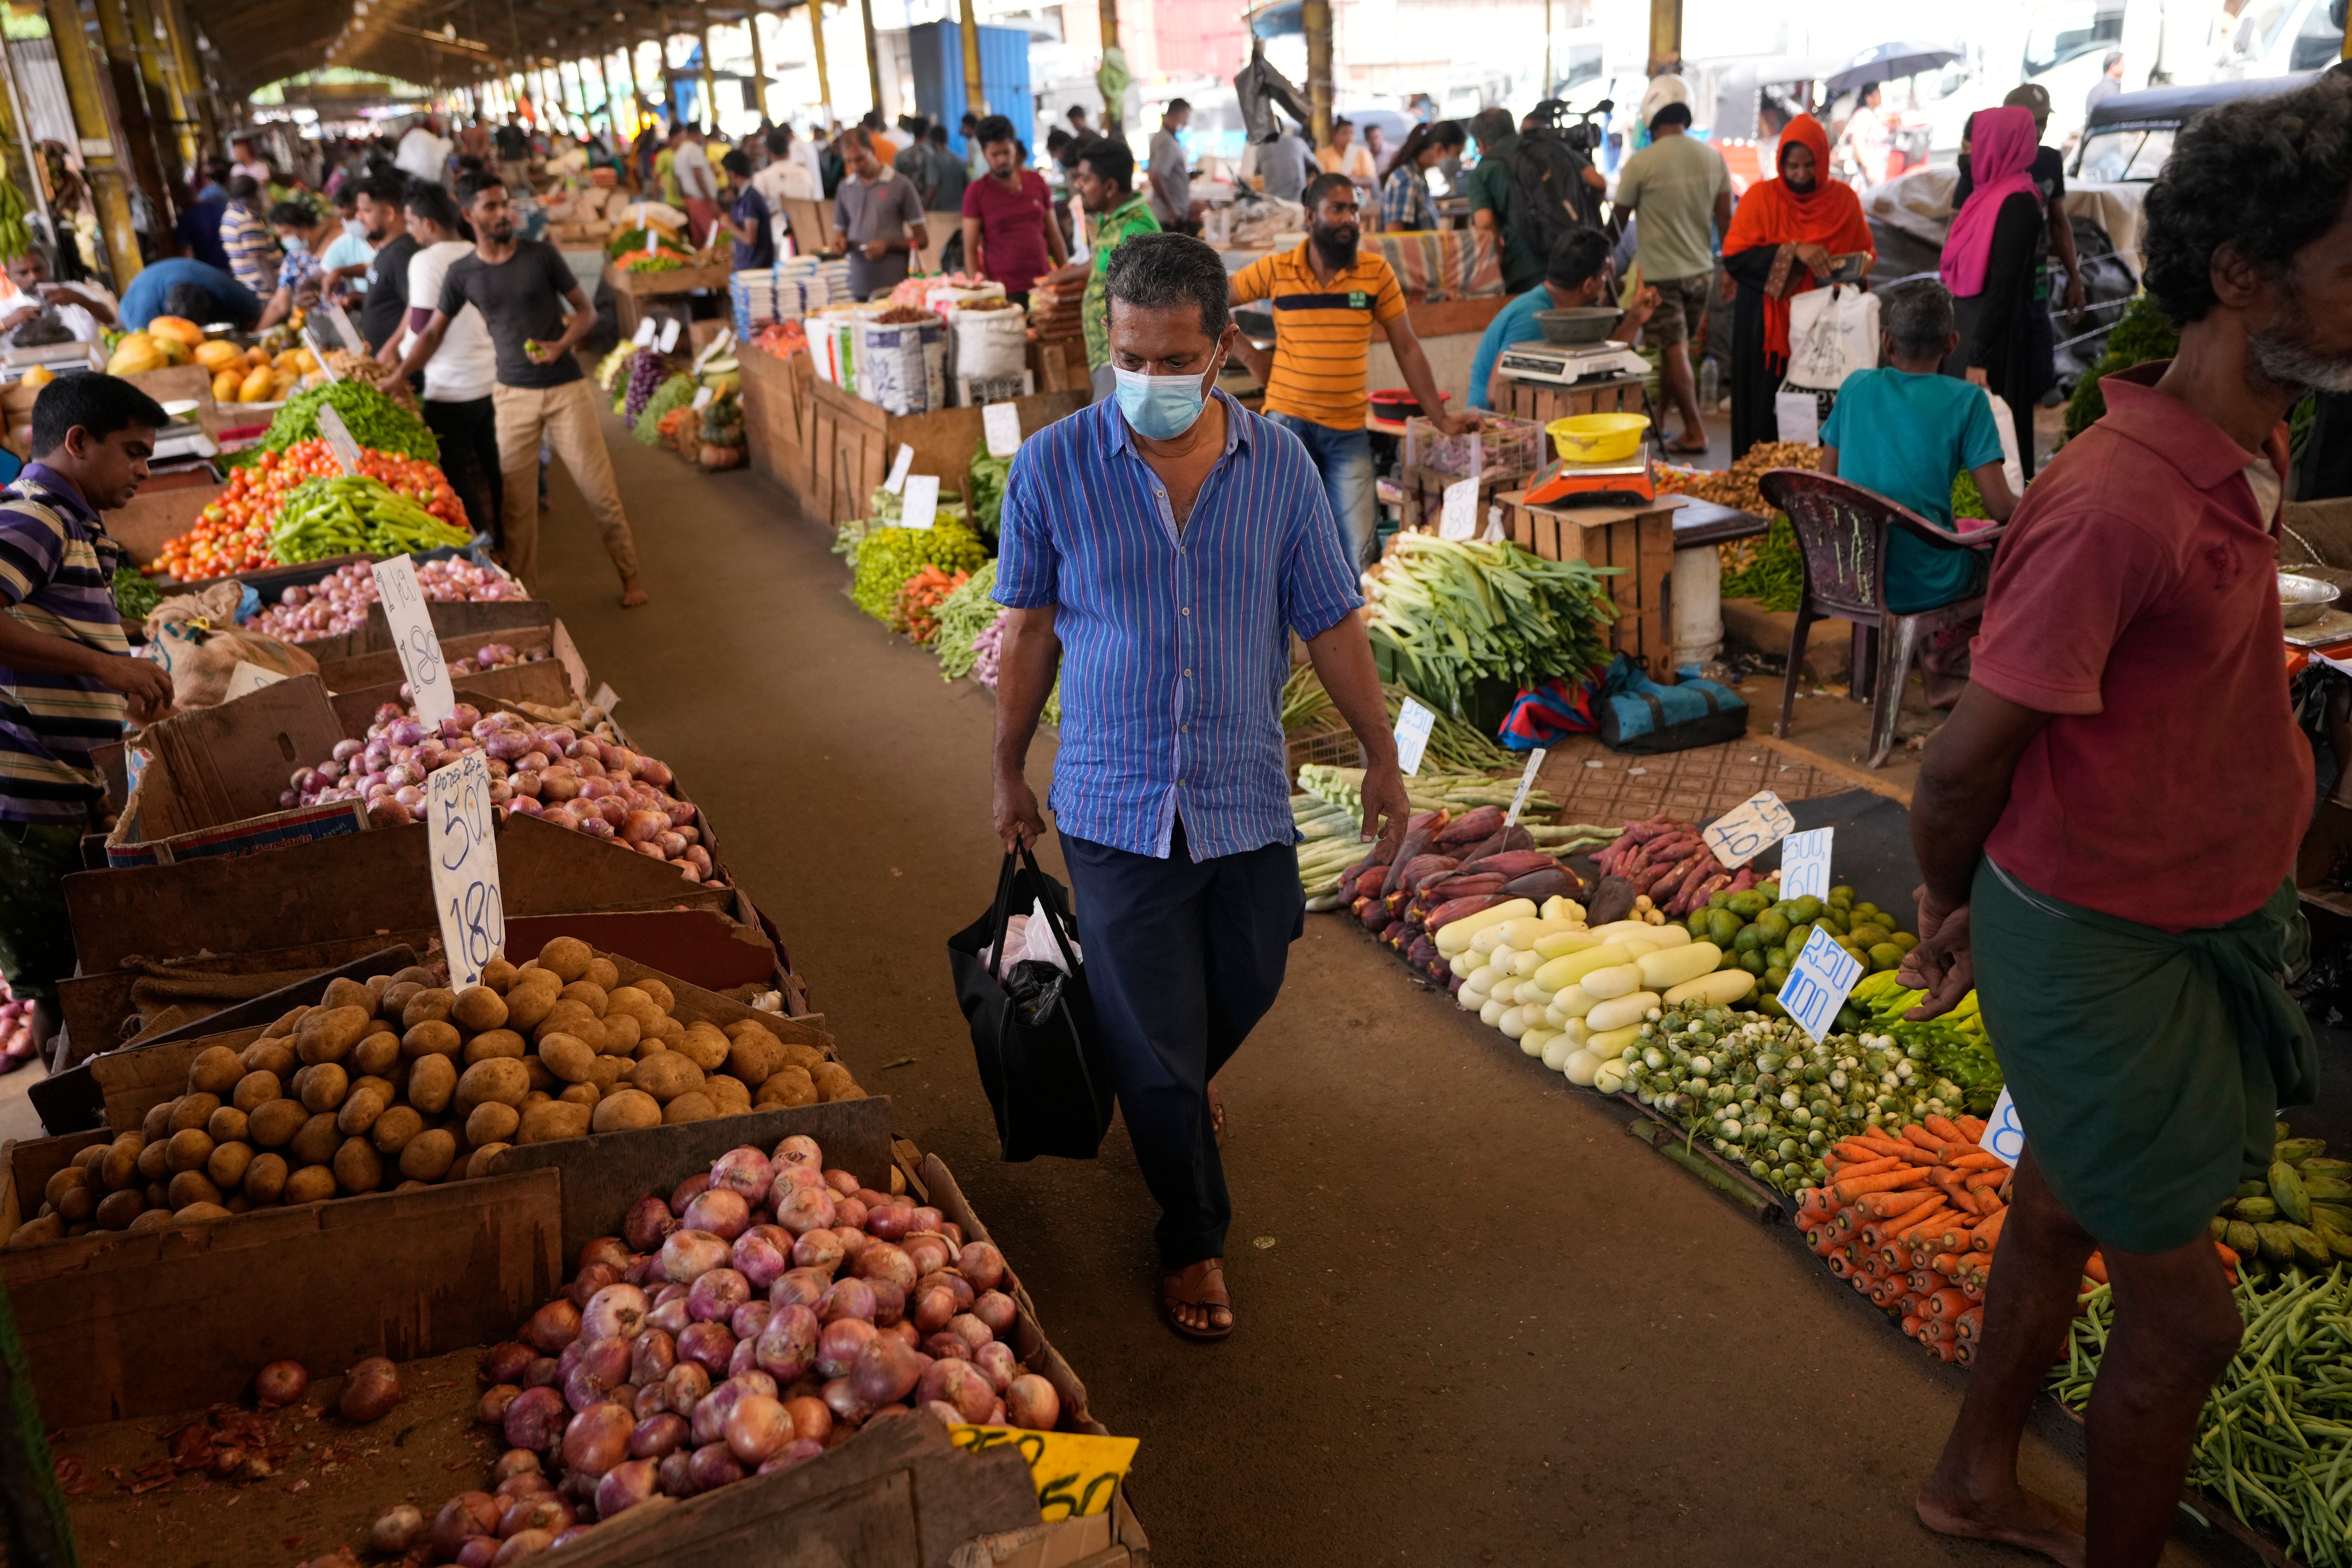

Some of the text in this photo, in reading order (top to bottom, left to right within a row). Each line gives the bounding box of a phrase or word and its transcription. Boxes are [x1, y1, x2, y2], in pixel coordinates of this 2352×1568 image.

[401, 625, 440, 694] 180
[1400, 698, 1433, 735] 250
[443, 775, 493, 871] 500
[1751, 791, 1790, 832] 250
[253, 834, 312, 854] Mandarin
[1711, 820, 1759, 855] 40
[1788, 863, 1820, 899] 60
[450, 881, 501, 983] 180
[1801, 928, 1855, 990] 250
[1780, 967, 1829, 1030] 100
